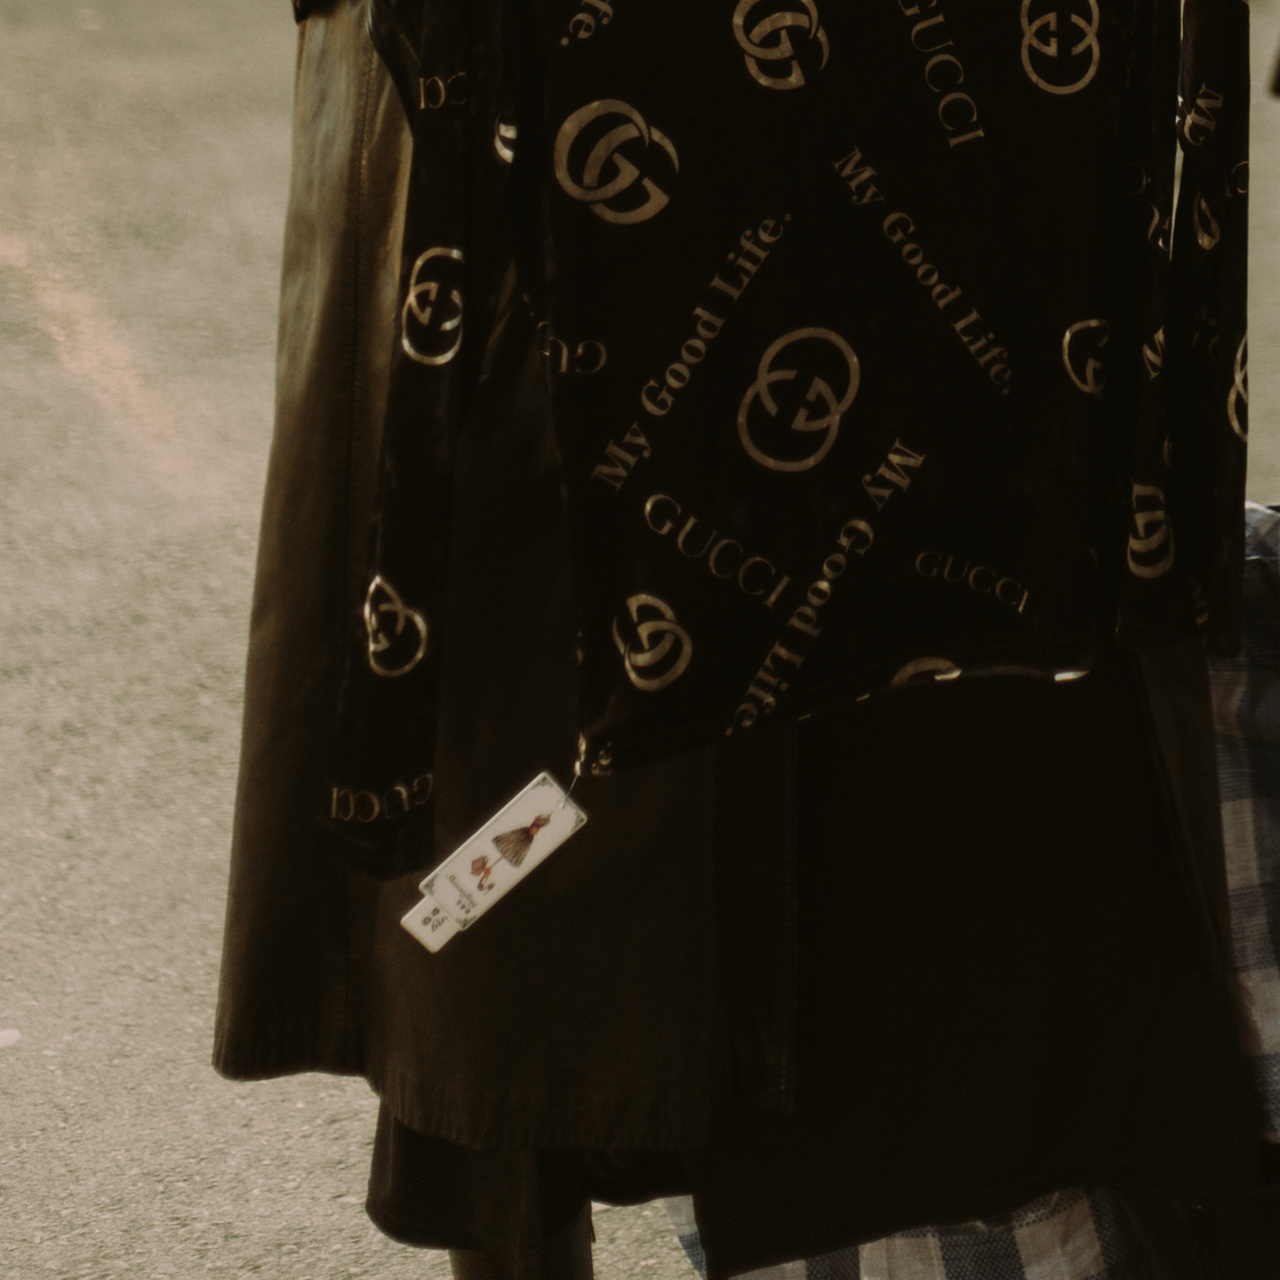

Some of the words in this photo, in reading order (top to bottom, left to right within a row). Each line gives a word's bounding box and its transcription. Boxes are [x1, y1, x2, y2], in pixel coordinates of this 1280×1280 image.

[831, 145, 885, 208] My
[882, 211, 963, 310] Good
[590, 420, 652, 492] My
[640, 305, 726, 418] Good
[708, 212, 793, 303] Life.
[861, 437, 927, 511] My
[643, 493, 792, 611] GUCCI
[786, 517, 874, 638] Good
[914, 549, 1031, 614] GUCCI
